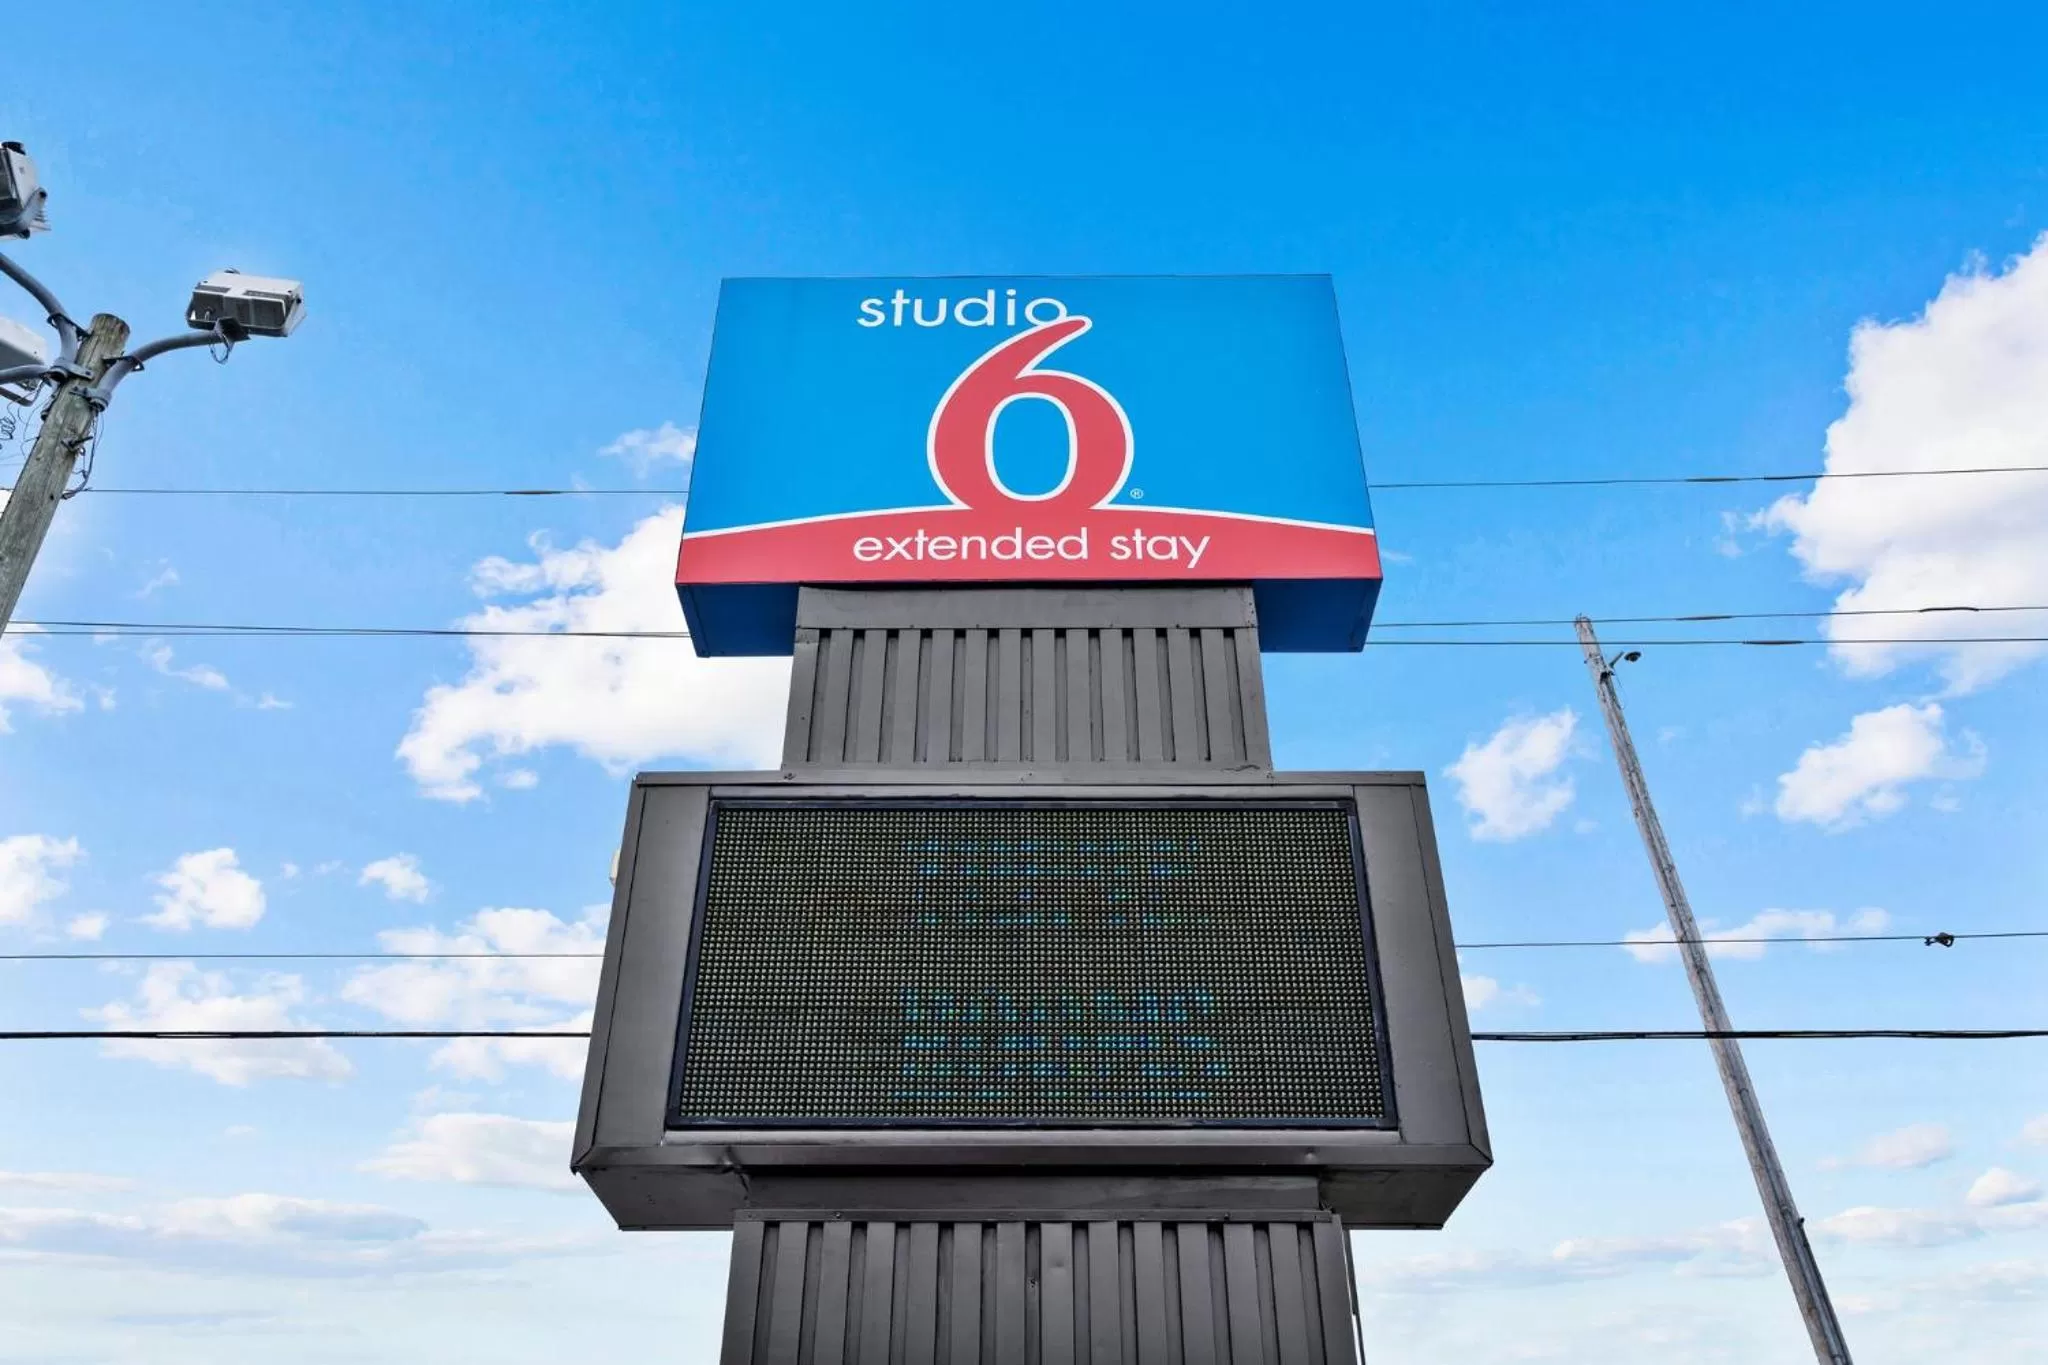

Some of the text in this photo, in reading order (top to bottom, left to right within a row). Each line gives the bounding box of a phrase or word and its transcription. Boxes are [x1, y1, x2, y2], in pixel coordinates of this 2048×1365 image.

[857, 289, 1067, 327] studio
[926, 315, 1135, 509] 6
[852, 526, 1211, 569] extended stay
